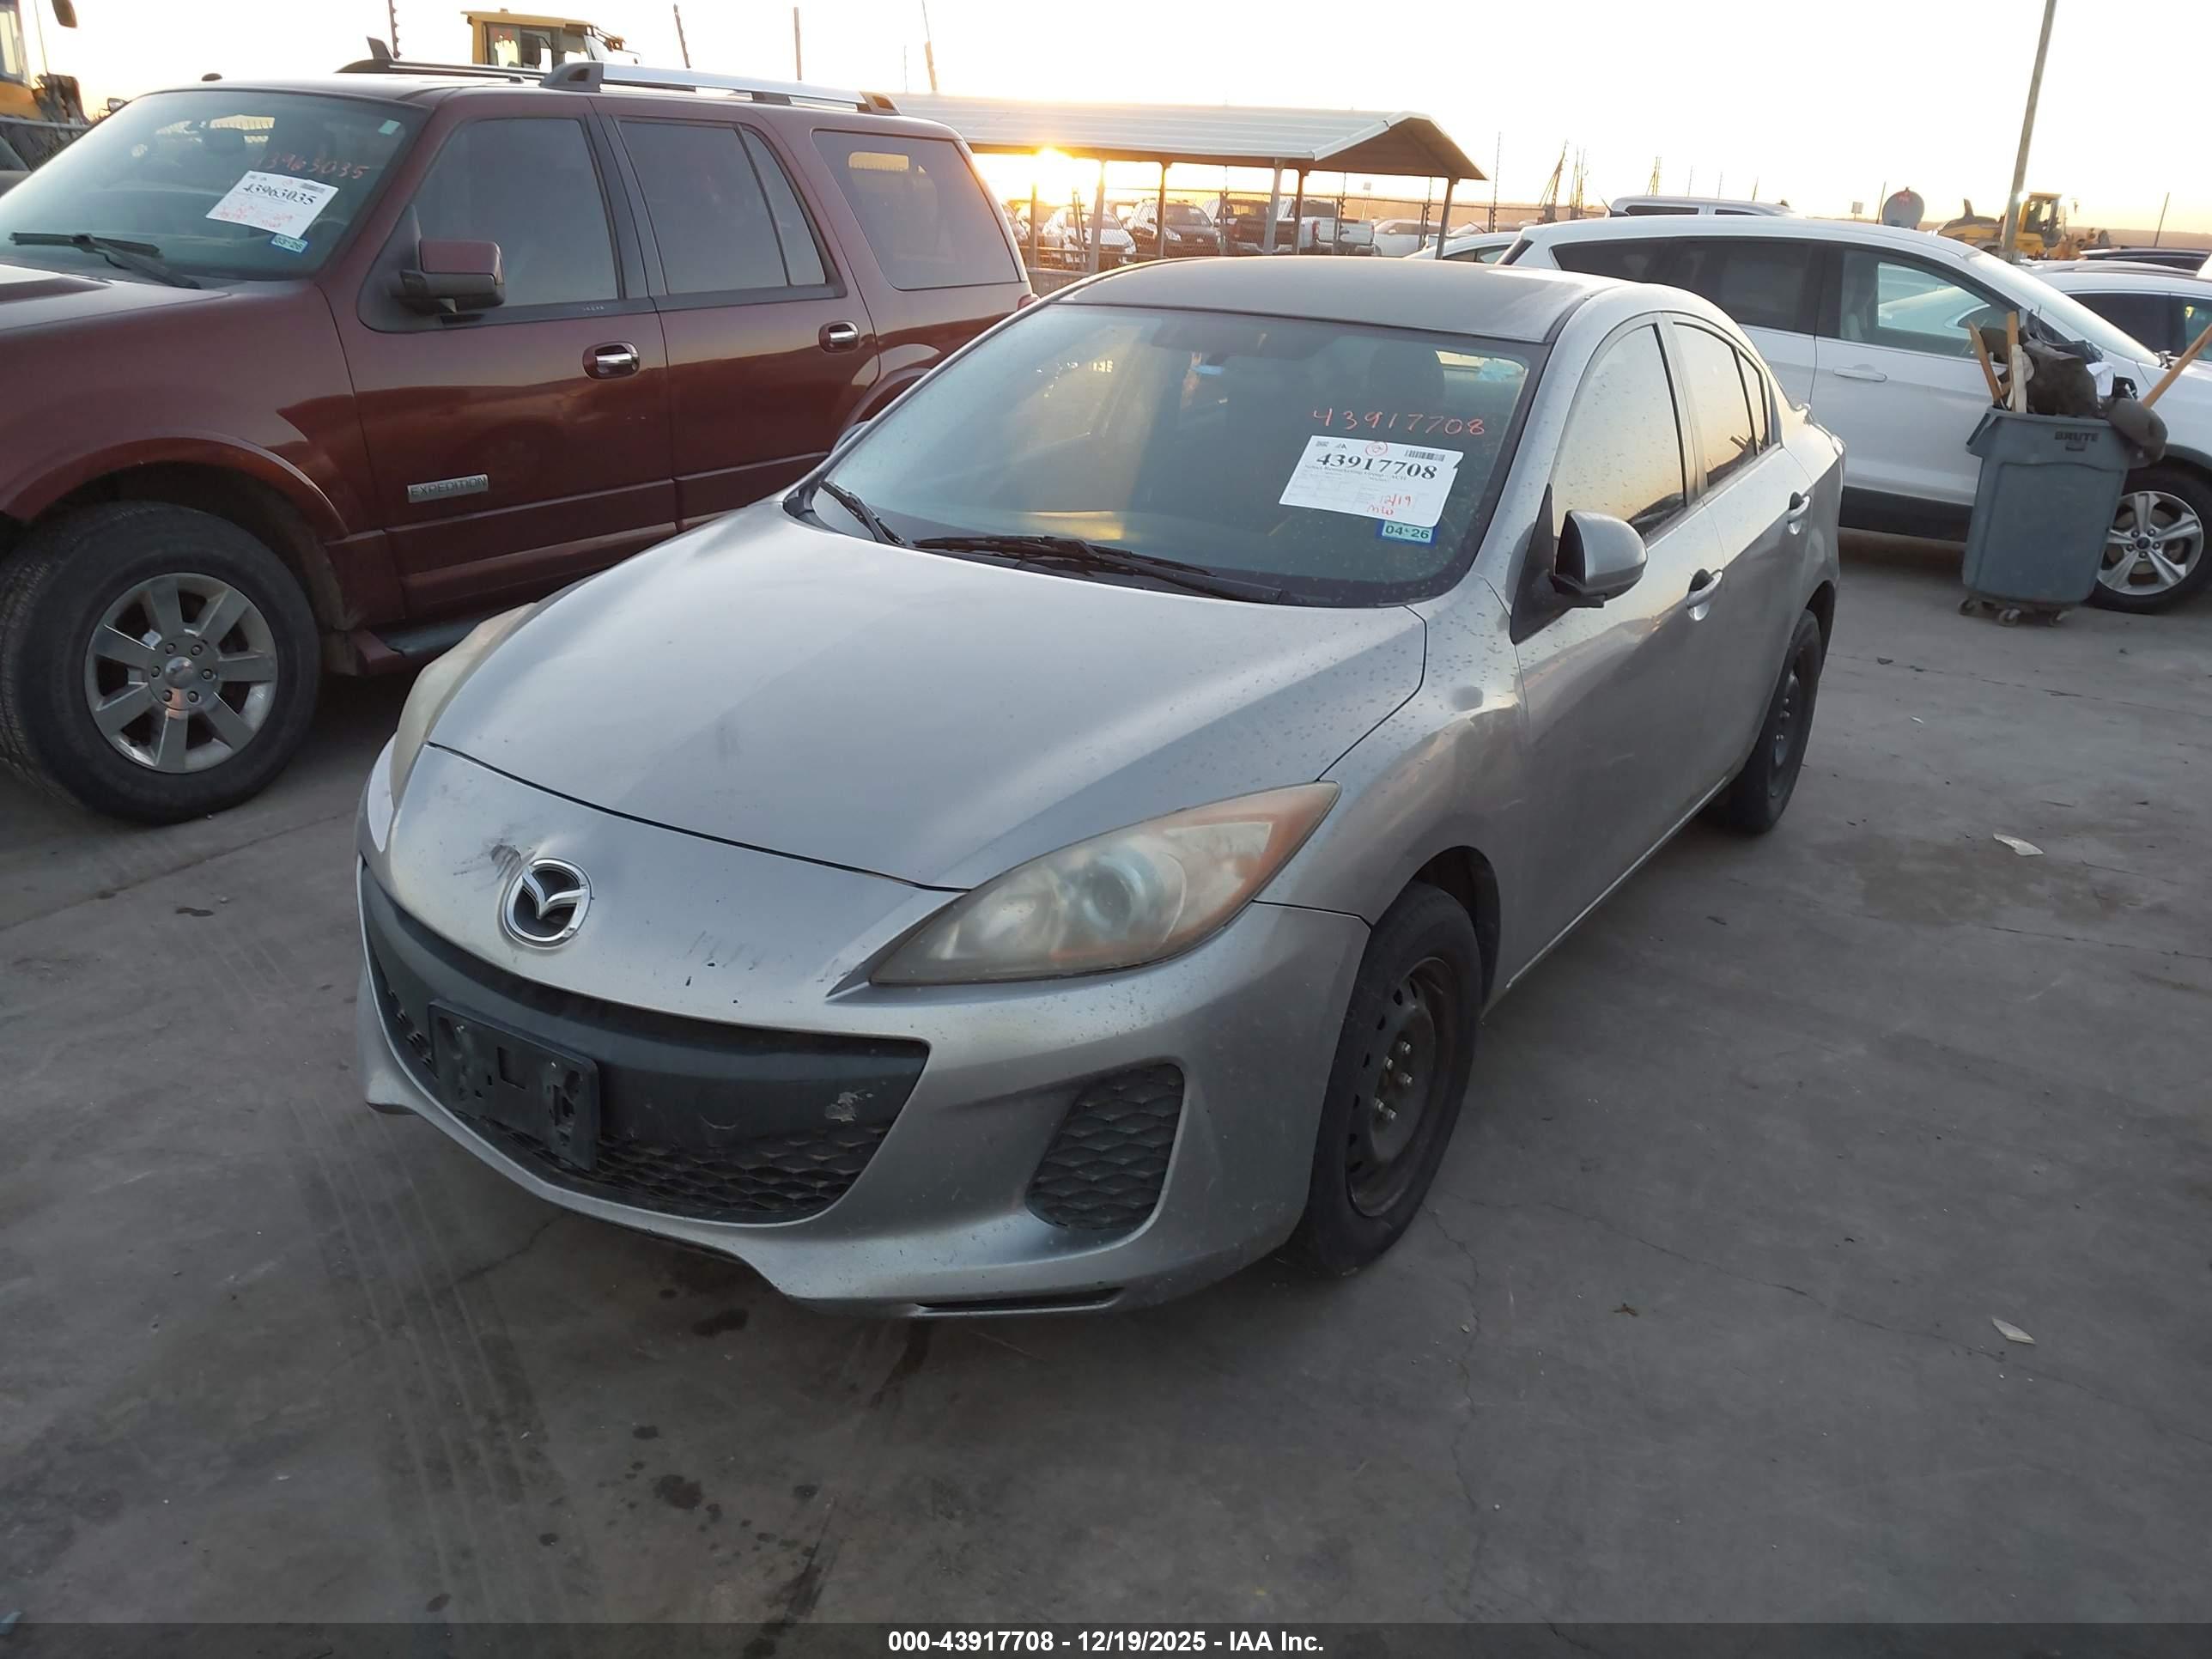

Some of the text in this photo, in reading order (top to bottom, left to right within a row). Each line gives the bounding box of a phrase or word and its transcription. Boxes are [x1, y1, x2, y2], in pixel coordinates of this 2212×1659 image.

[1313, 408, 1486, 436] 43917708
[2055, 431, 2100, 441] BRUTE
[1316, 453, 1437, 480] 43917708
[410, 477, 487, 495] EXPEDITION
[1385, 525, 1430, 539] 04 26
